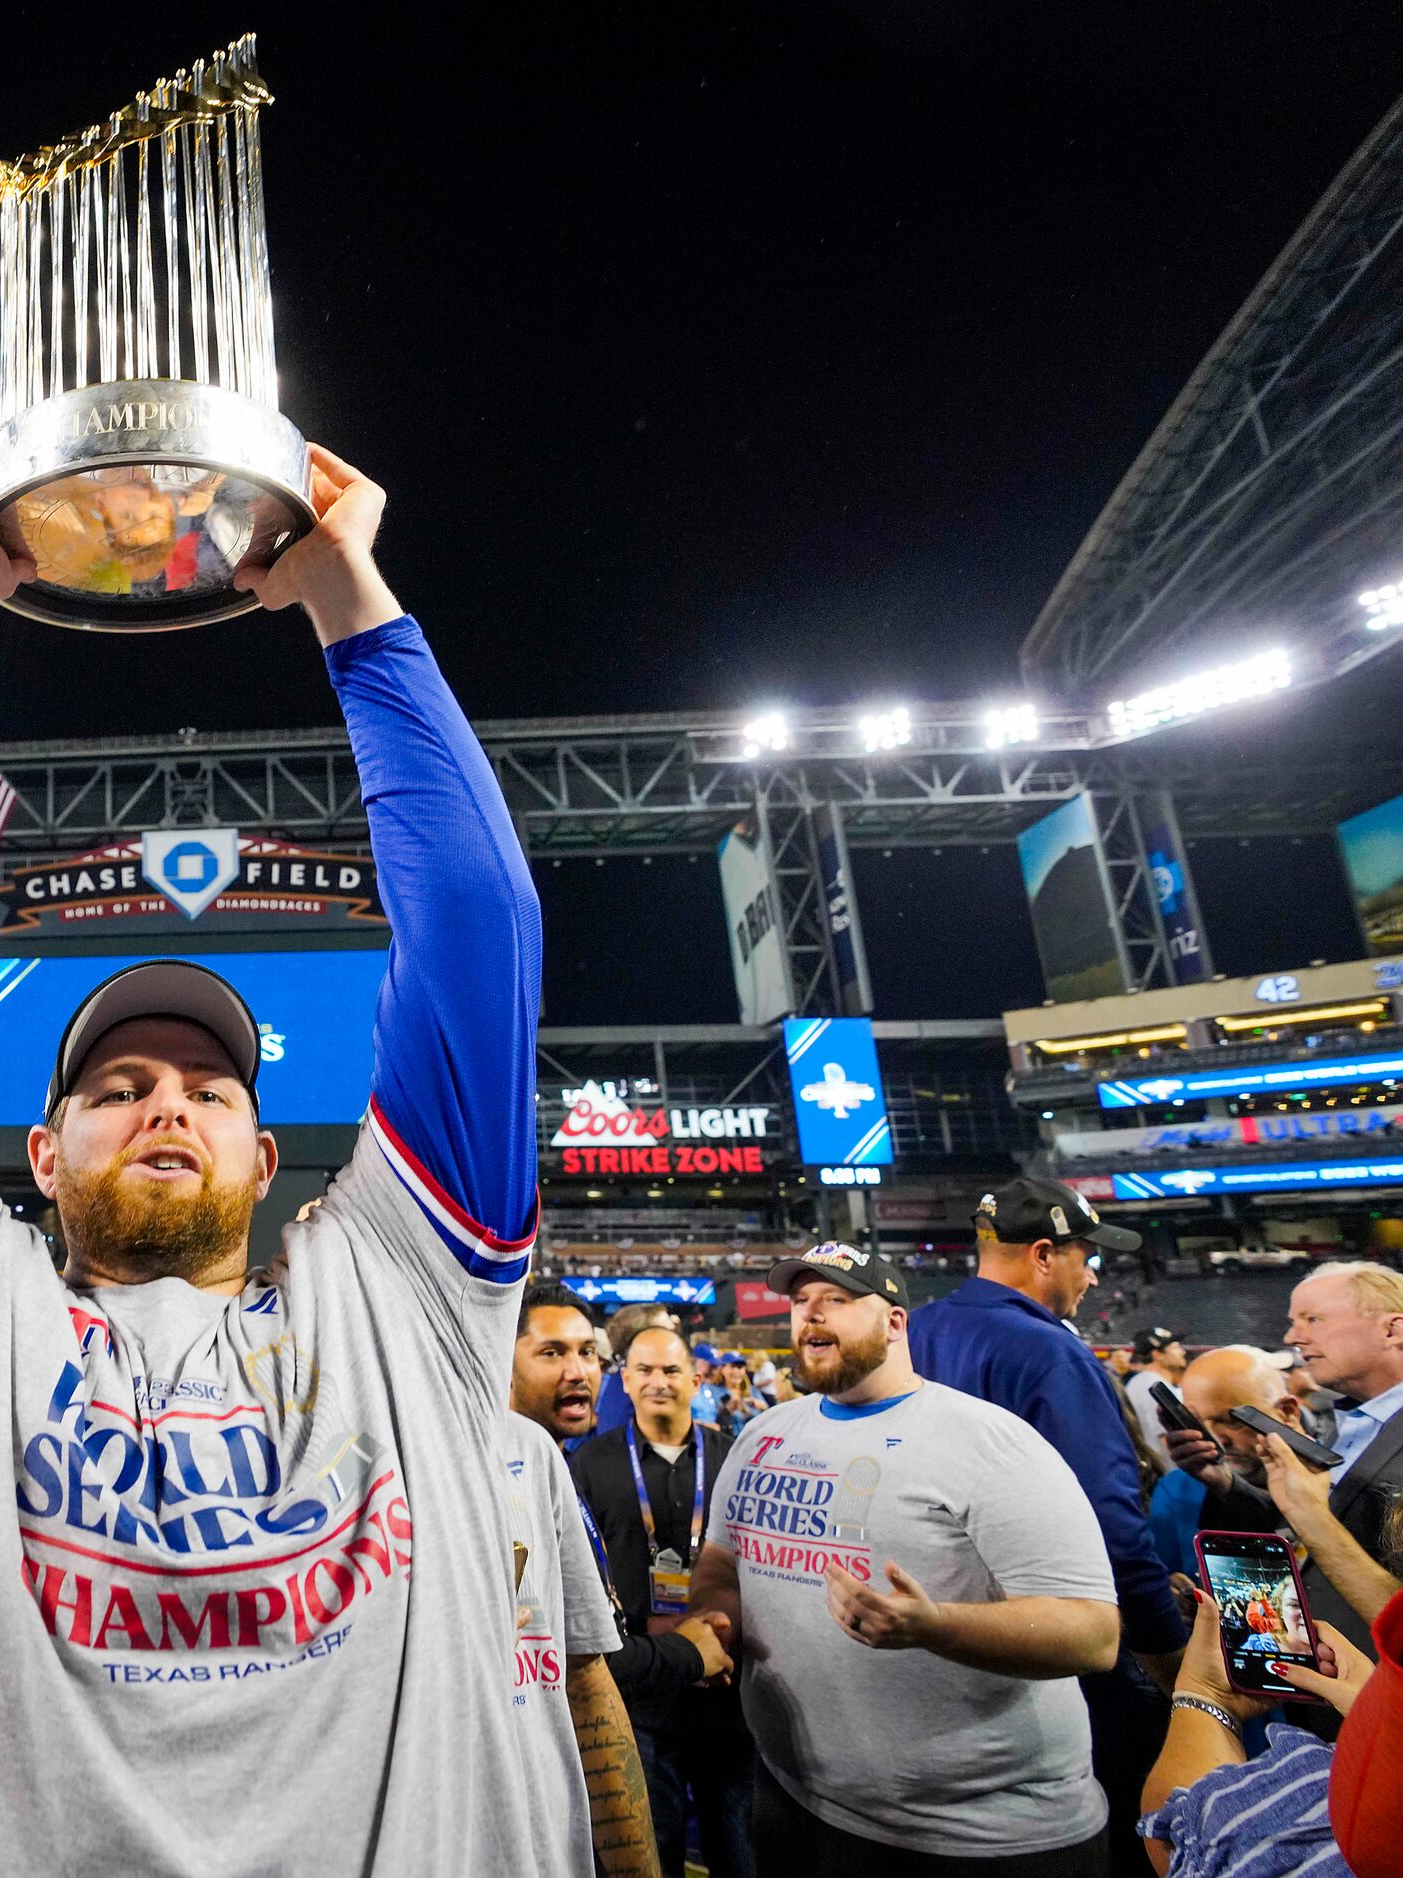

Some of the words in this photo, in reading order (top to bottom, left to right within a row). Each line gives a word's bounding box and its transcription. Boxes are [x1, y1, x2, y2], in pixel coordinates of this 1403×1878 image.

[25, 867, 137, 899] CHASE
[247, 863, 362, 889] FIELD
[65, 906, 103, 919] HOME
[113, 903, 130, 914] OF
[141, 901, 166, 911] THE
[216, 899, 321, 912] DIAMONDBACKS
[1255, 975, 1302, 1003] 42
[560, 1099, 671, 1138] Coors
[670, 1109, 769, 1138] LIGHT
[1263, 1111, 1388, 1140] ULTRA
[562, 1147, 671, 1174] STRIKE
[676, 1147, 764, 1173] ZONE
[749, 1436, 785, 1468] T
[736, 1469, 834, 1507] WORLD
[725, 1494, 831, 1537] SERIES
[748, 1566, 776, 1579] TEXAS
[777, 1571, 823, 1588] RANGERS
[102, 1662, 211, 1684] TEXAS
